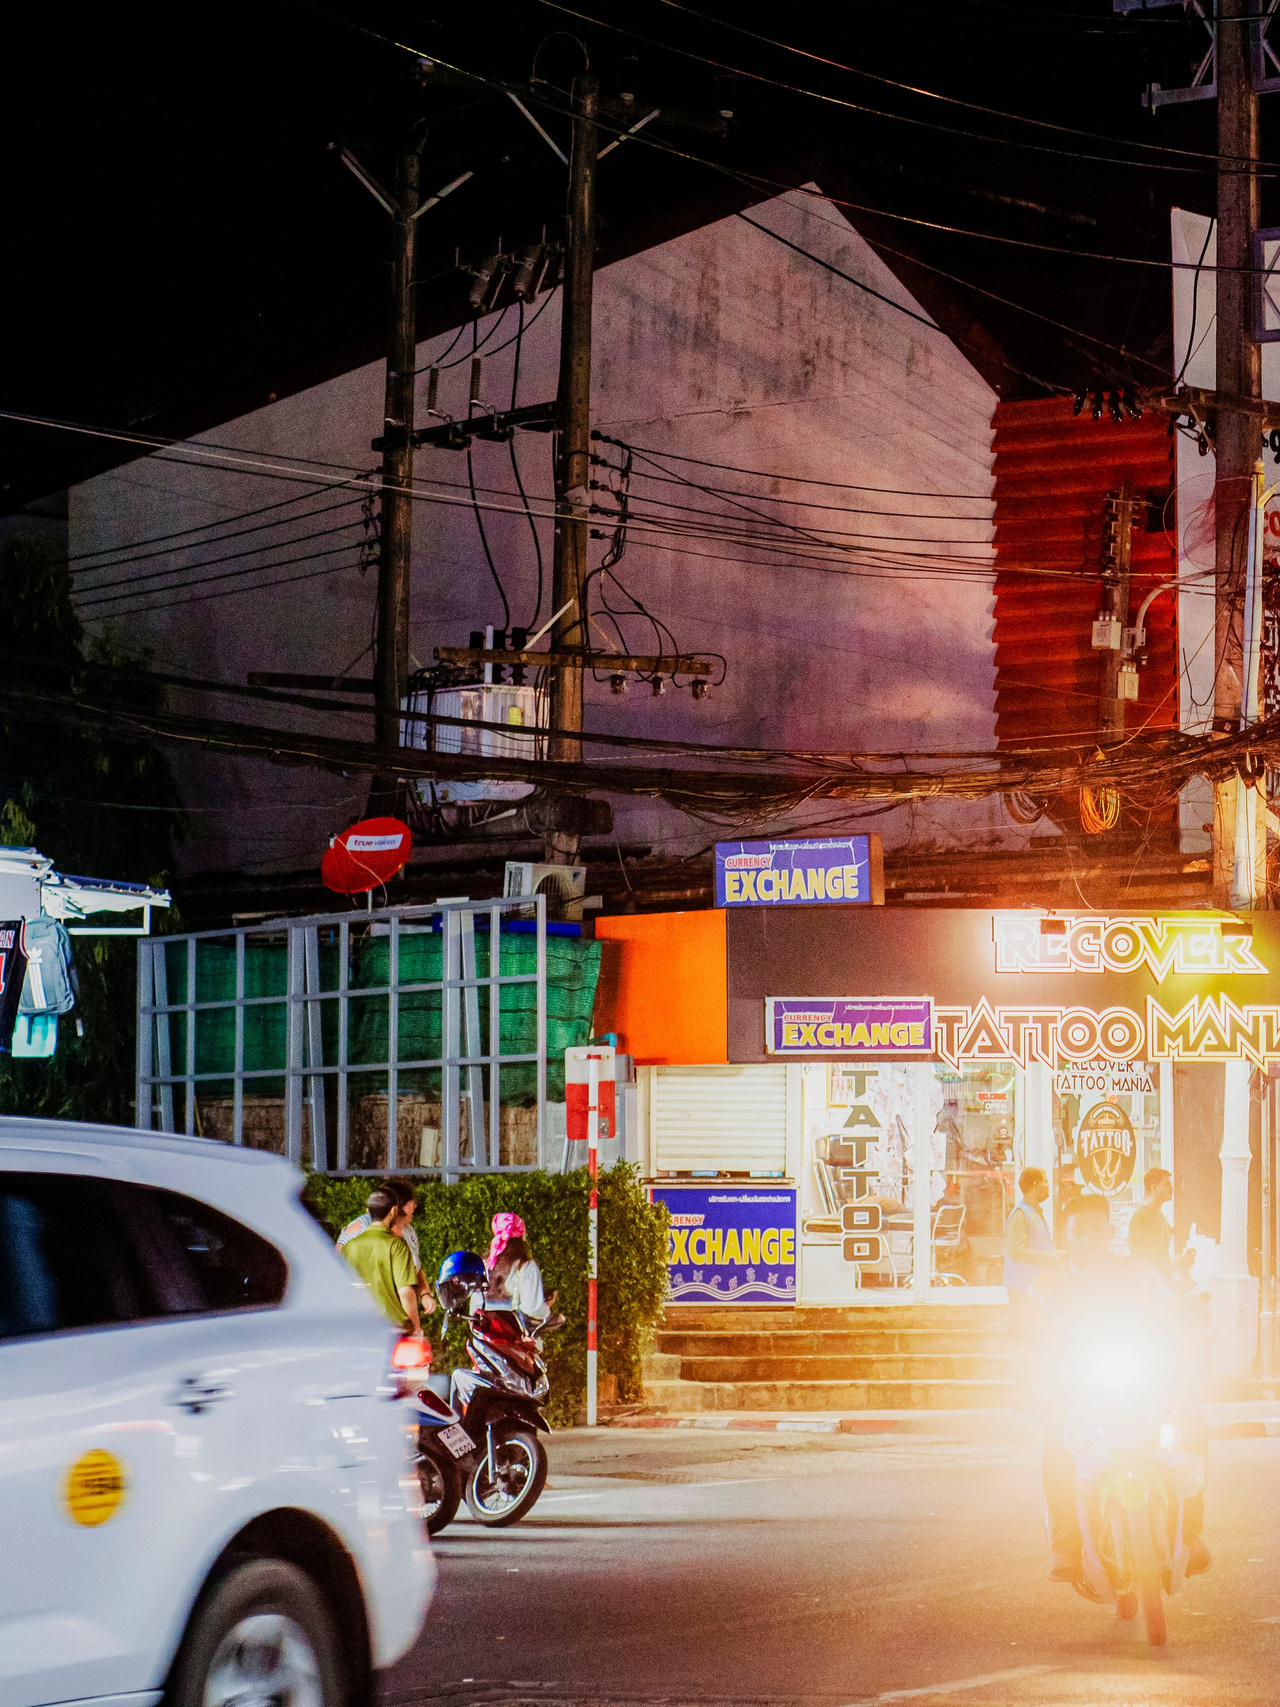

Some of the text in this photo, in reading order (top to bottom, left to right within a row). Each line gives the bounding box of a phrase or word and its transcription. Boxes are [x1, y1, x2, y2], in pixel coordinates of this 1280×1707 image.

[354, 839, 374, 847] true
[726, 857, 772, 868] CURRENCY
[726, 867, 859, 902] EXCHANGE
[993, 916, 1269, 985] RECOVER
[784, 1014, 832, 1022] CURRENCY
[784, 1022, 925, 1047] EXCHANGE
[934, 996, 1146, 1076] TATTOO
[1056, 1074, 1153, 1093] TATTOO MANIA
[985, 1102, 1007, 1110] OPEN
[1080, 1128, 1133, 1159] TATTOO
[841, 1070, 882, 1263] TATTOO
[671, 1215, 704, 1226] RENCY
[669, 1228, 795, 1265] XCHANGE
